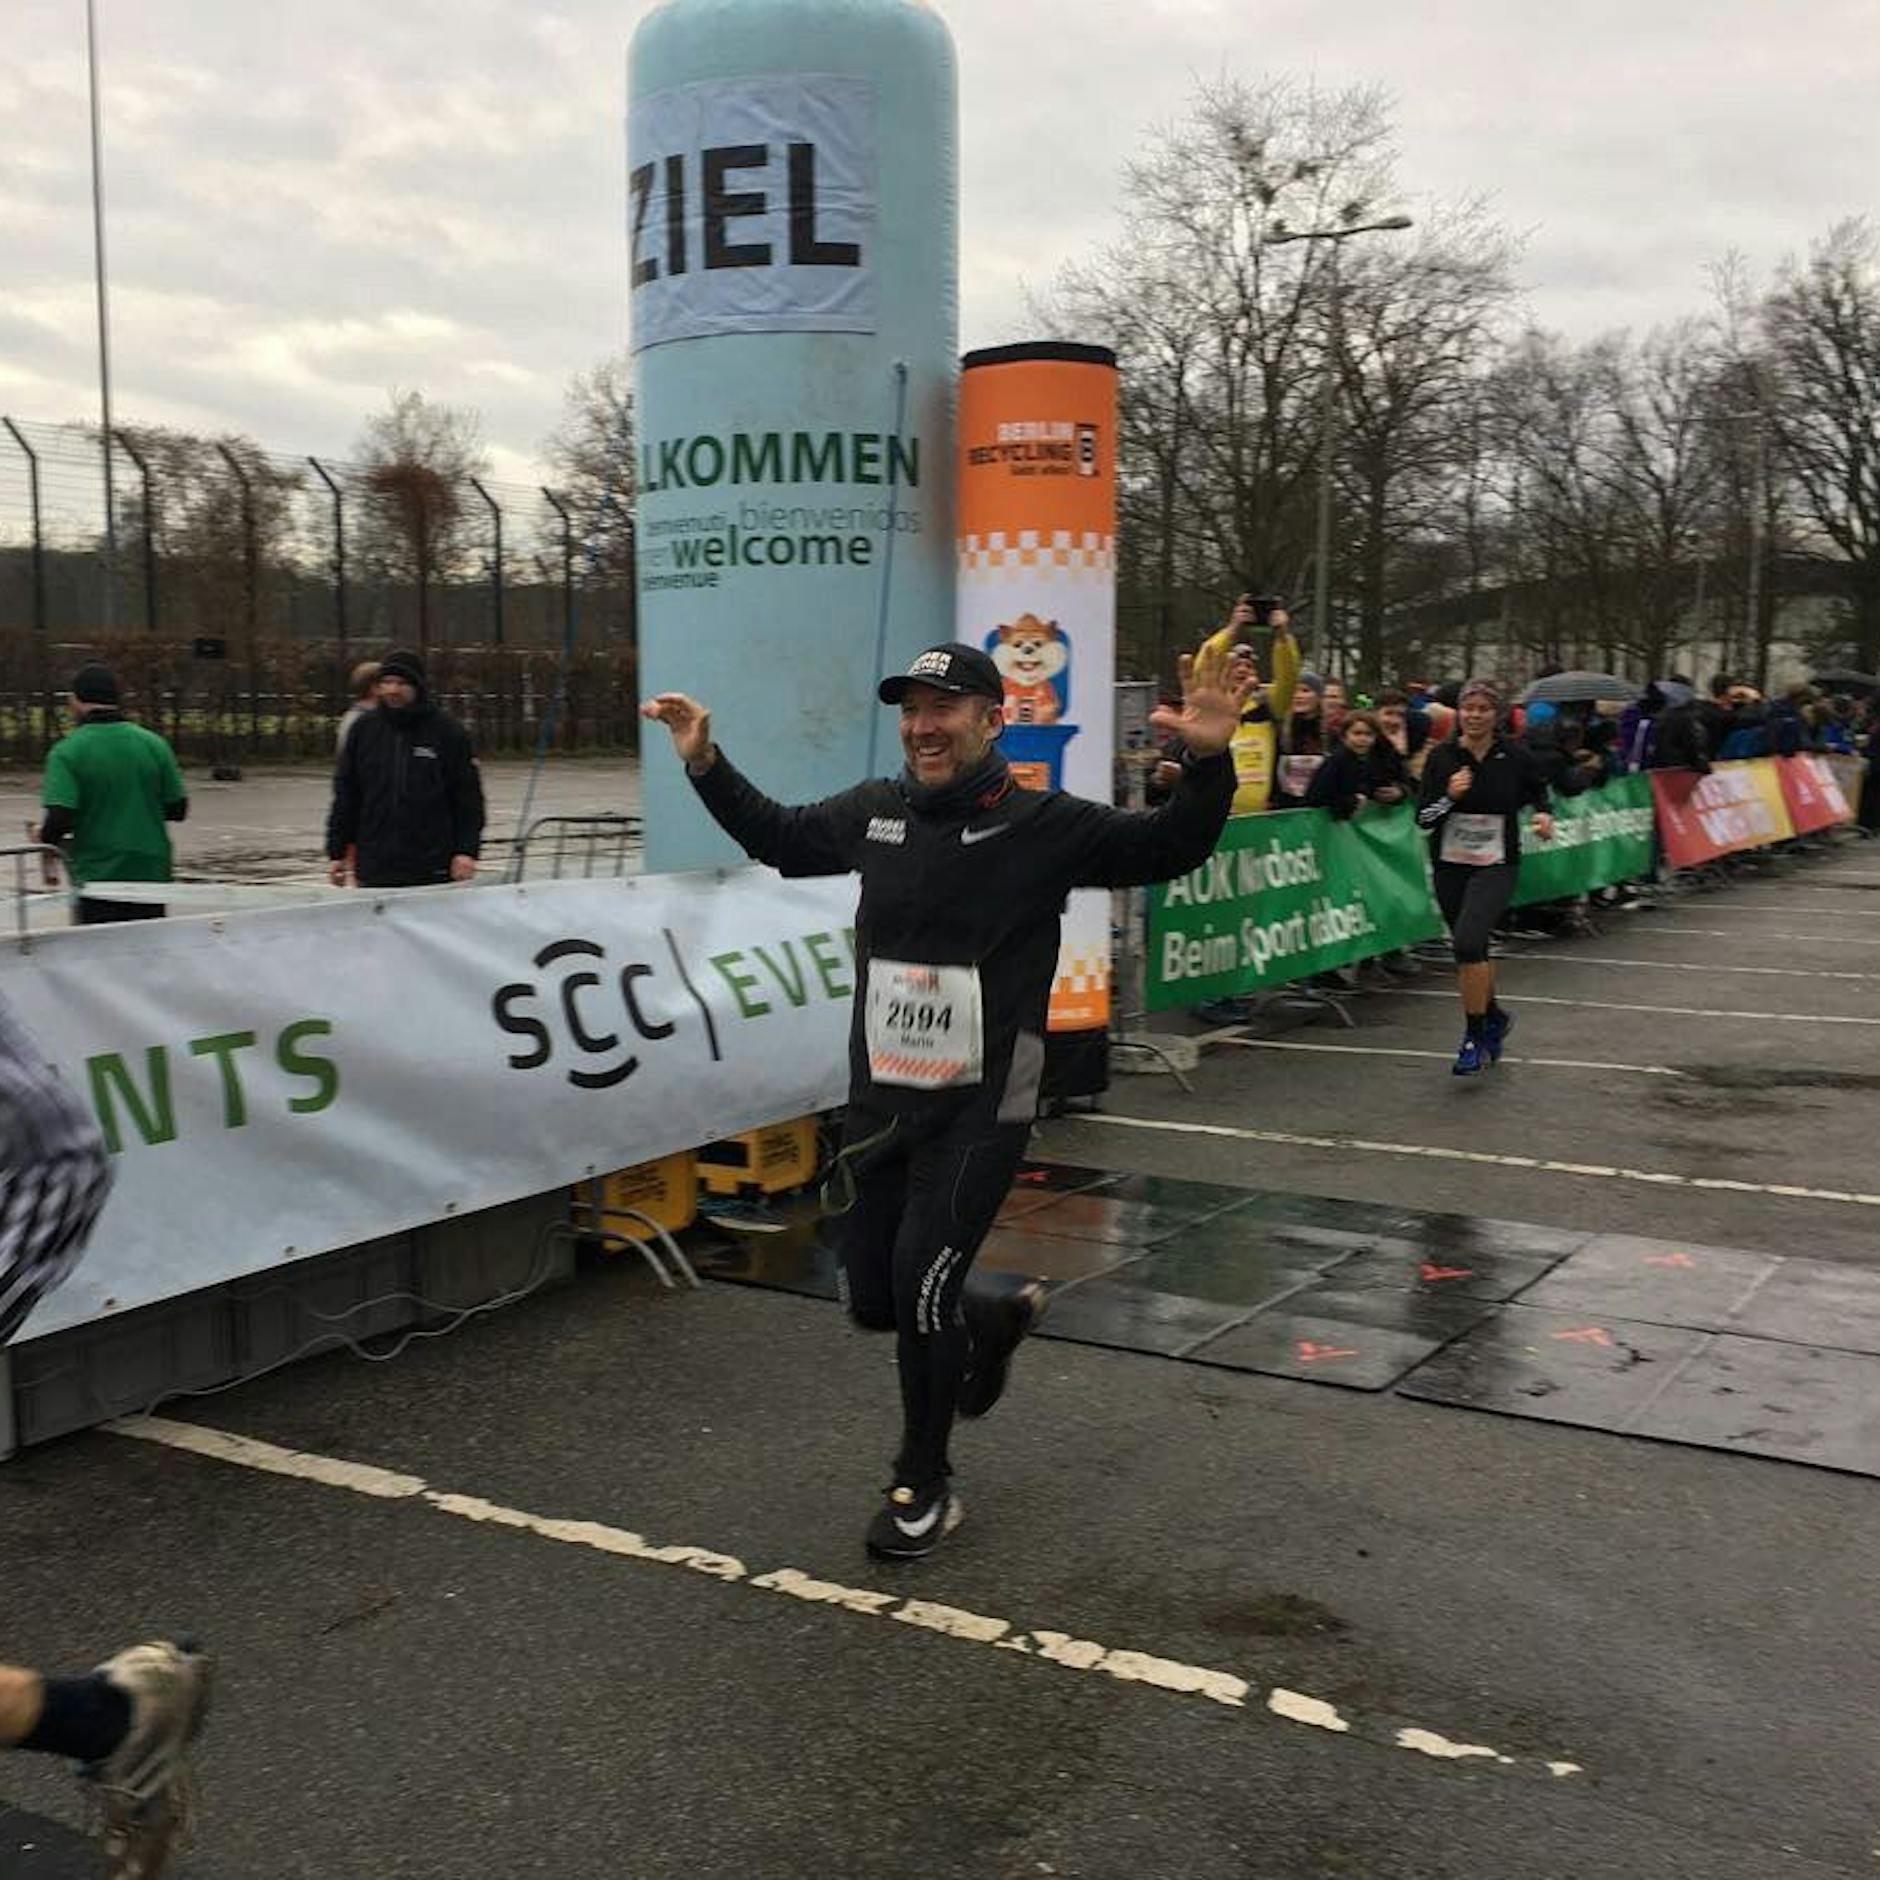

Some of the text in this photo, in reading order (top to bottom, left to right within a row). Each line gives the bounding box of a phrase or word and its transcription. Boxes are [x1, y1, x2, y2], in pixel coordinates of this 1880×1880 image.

[630, 143, 860, 289] ZIEL
[671, 524, 873, 568] welcome
[492, 926, 857, 1070] SCC EVE
[1162, 923, 1237, 982] Beim
